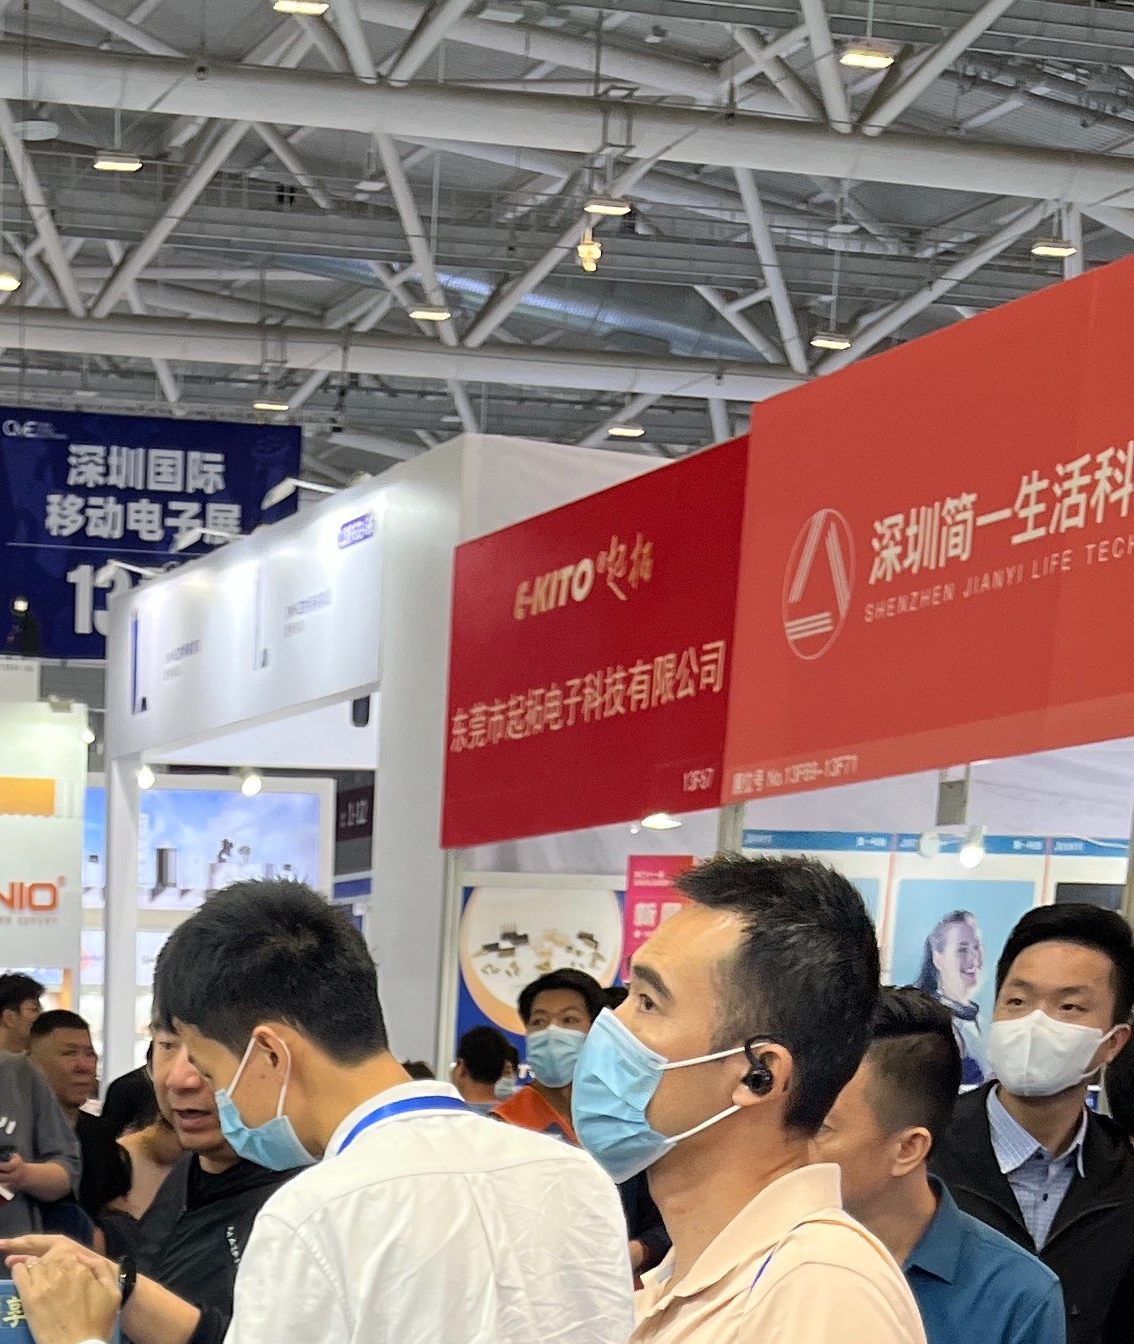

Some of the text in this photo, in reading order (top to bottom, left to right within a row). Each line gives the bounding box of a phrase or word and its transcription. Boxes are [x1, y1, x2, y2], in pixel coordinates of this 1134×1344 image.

[67, 444, 226, 494] 深圳国际
[45, 493, 242, 545] 移动电子展
[513, 558, 595, 620] E-KITO
[864, 583, 956, 623] SHENZHEN
[963, 564, 1024, 599] JIANYI
[1031, 549, 1072, 580] LIFE
[450, 640, 727, 752] 东莞市起拓电子科技有限公司
